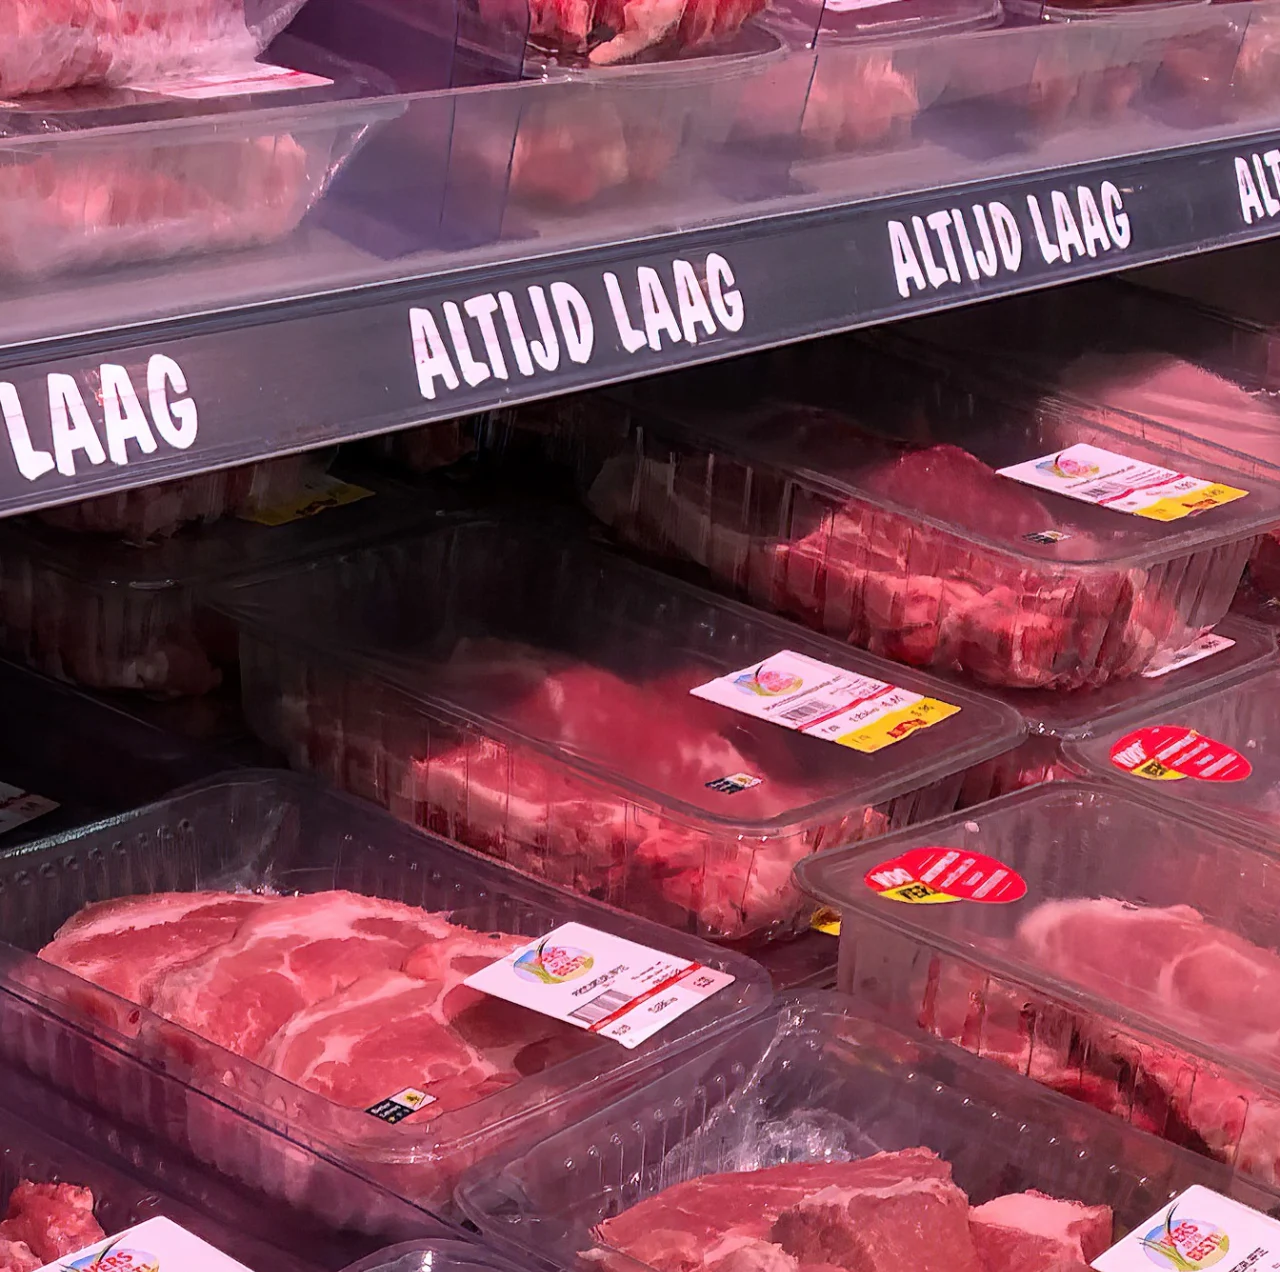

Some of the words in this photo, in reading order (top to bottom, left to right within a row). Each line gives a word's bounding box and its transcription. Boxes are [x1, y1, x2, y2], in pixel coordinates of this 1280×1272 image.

[887, 201, 1022, 299] ALTIJD
[1027, 180, 1132, 265] LAAG
[409, 280, 595, 400] ALTIJD
[603, 252, 745, 356] LAAG
